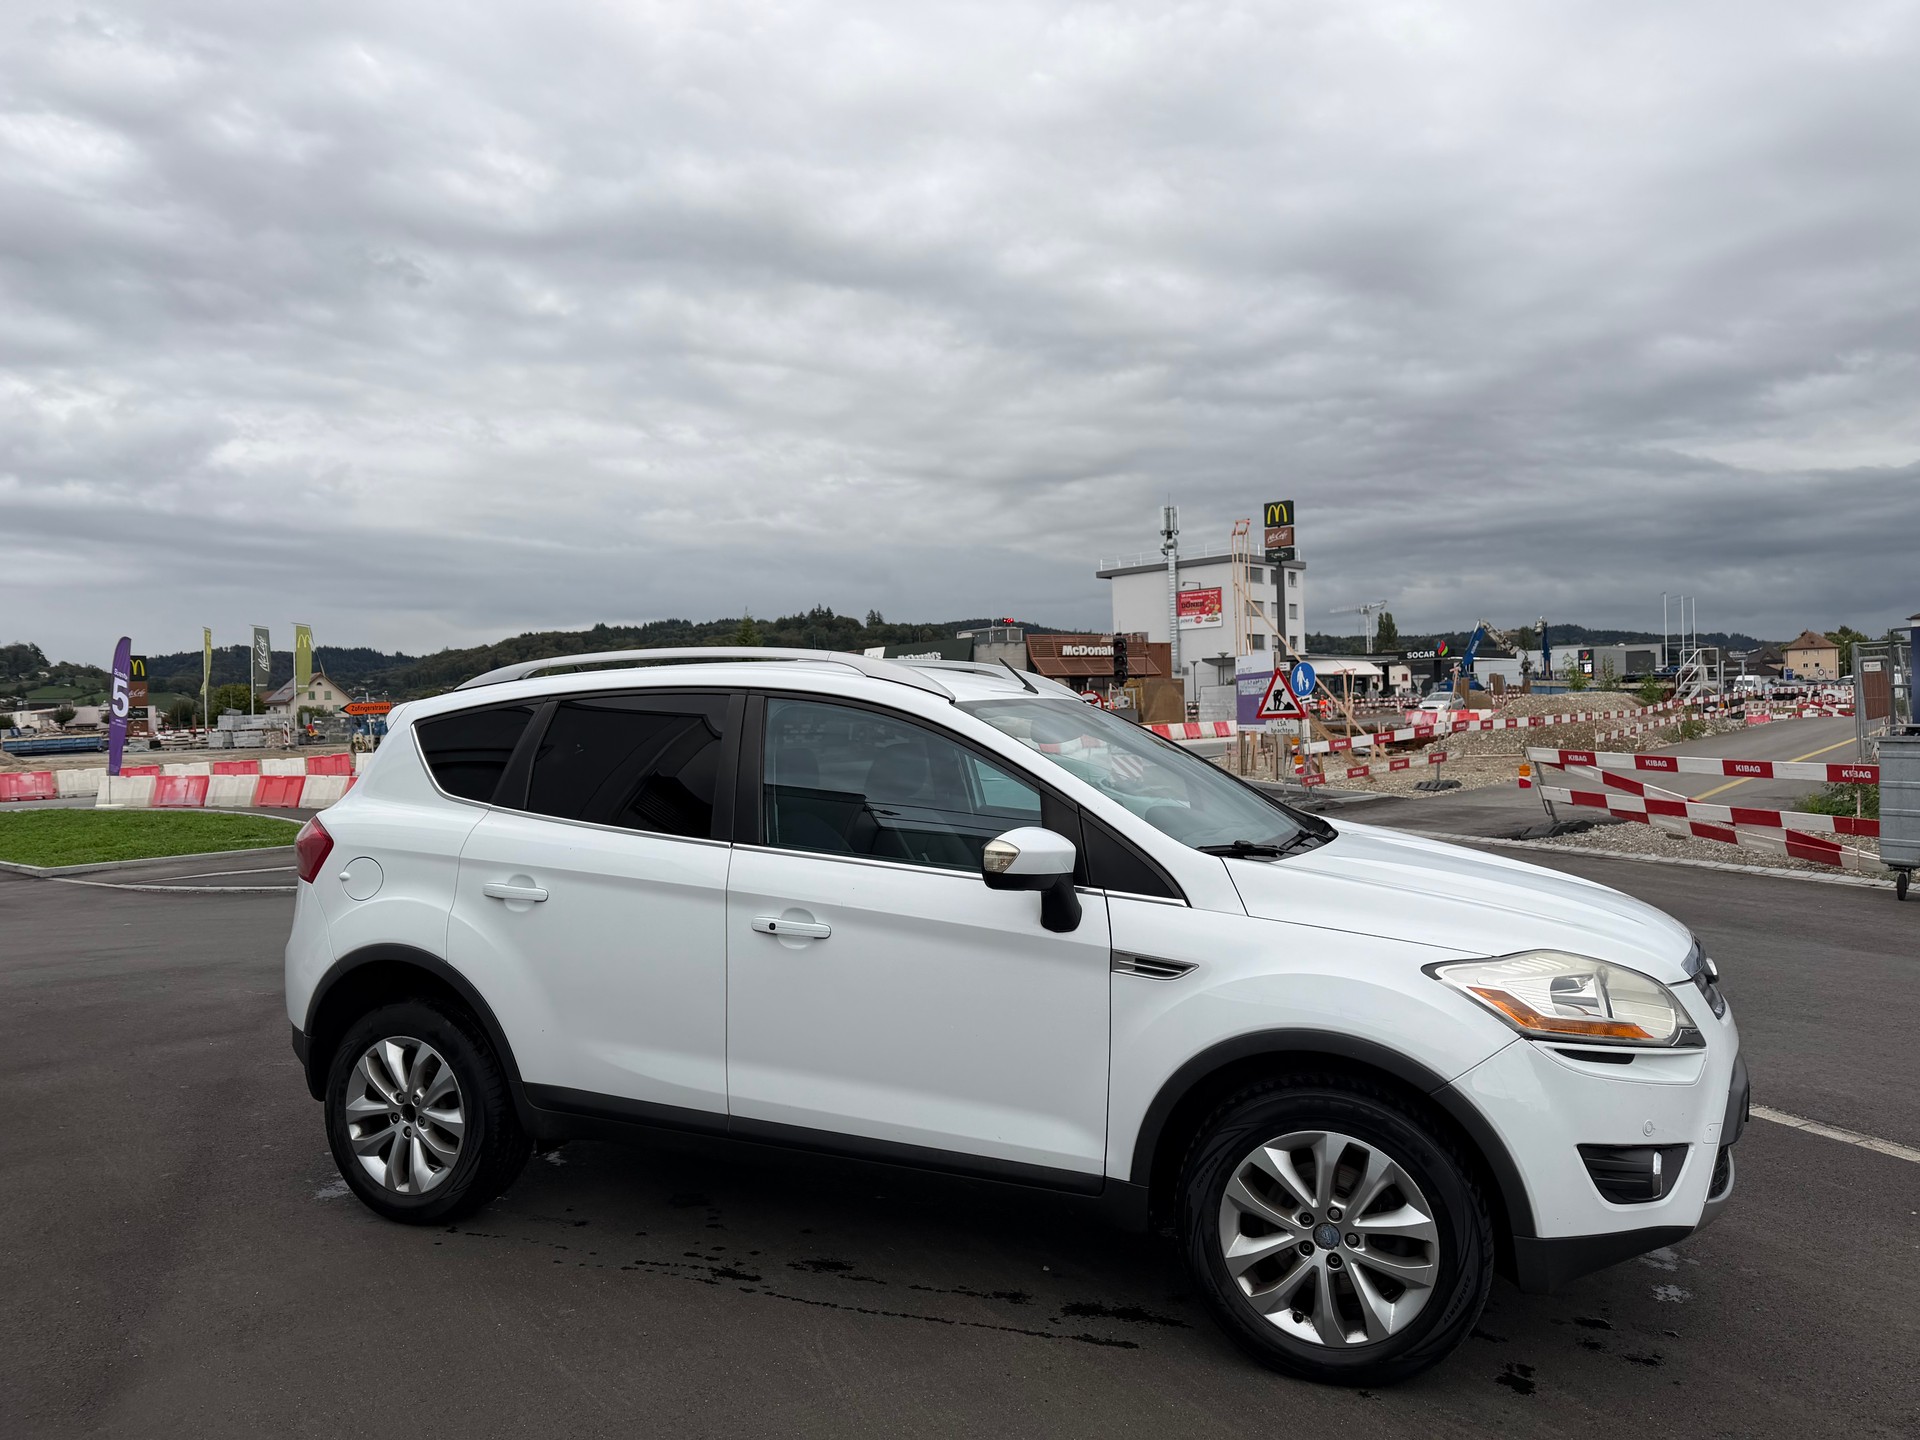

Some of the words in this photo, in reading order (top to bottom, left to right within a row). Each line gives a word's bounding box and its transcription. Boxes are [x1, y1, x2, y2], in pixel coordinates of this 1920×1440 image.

[1406, 650, 1435, 659] SOCAR
[112, 677, 129, 717] 5
[1735, 764, 1761, 773] KIBAG
[1841, 769, 1872, 779] KIBAG
